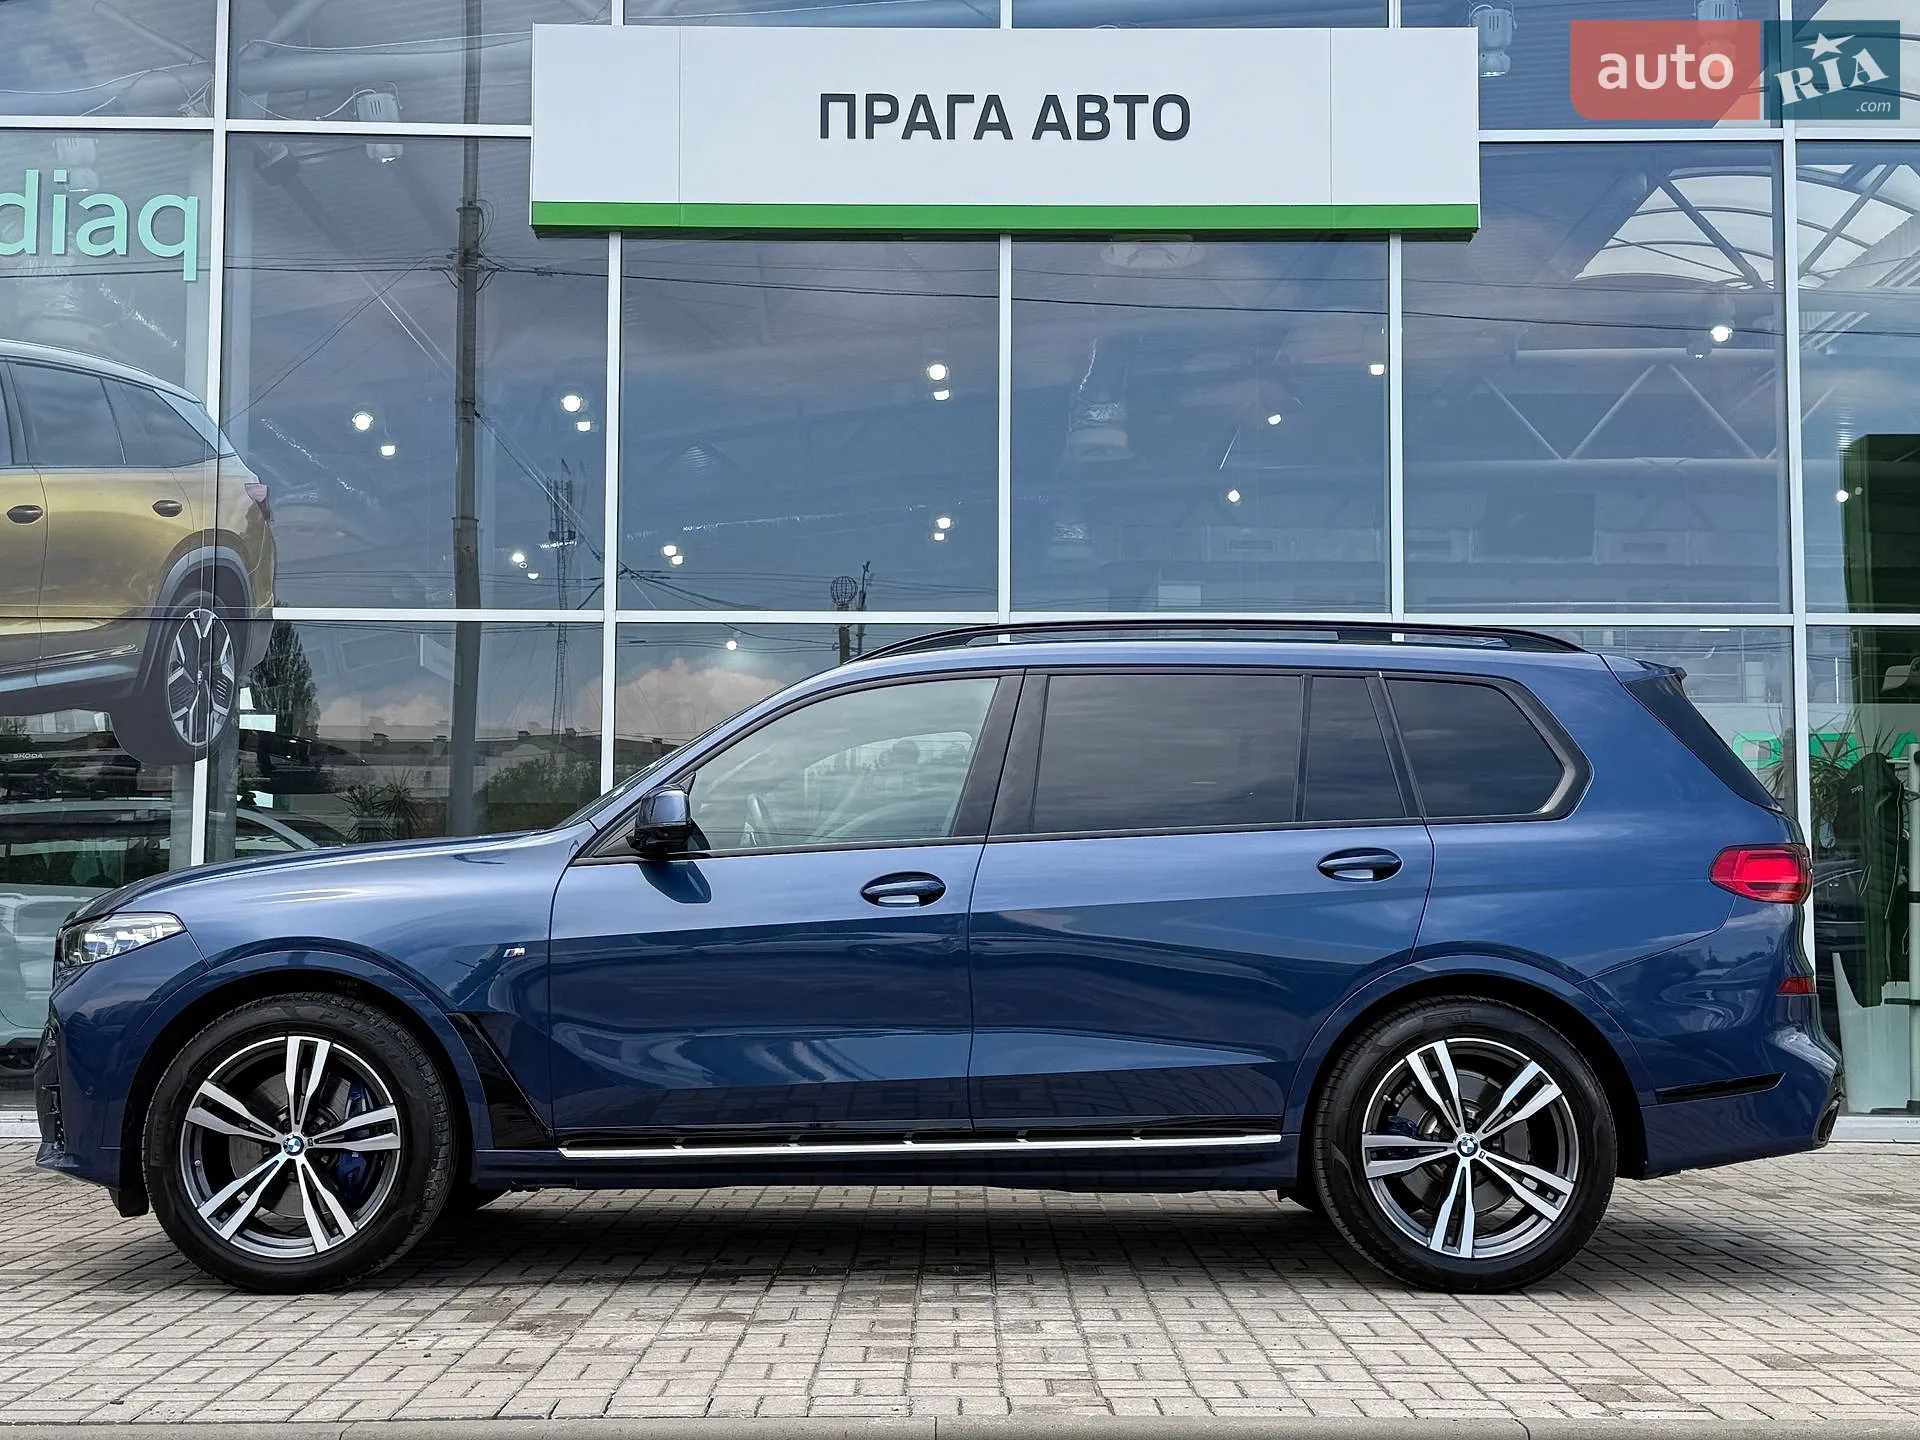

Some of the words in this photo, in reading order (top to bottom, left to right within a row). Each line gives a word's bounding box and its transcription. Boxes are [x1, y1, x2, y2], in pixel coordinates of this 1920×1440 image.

[819, 93, 1014, 141] ПРАГА
[1031, 93, 1191, 141] АВТО
[0, 169, 199, 282] diaq
